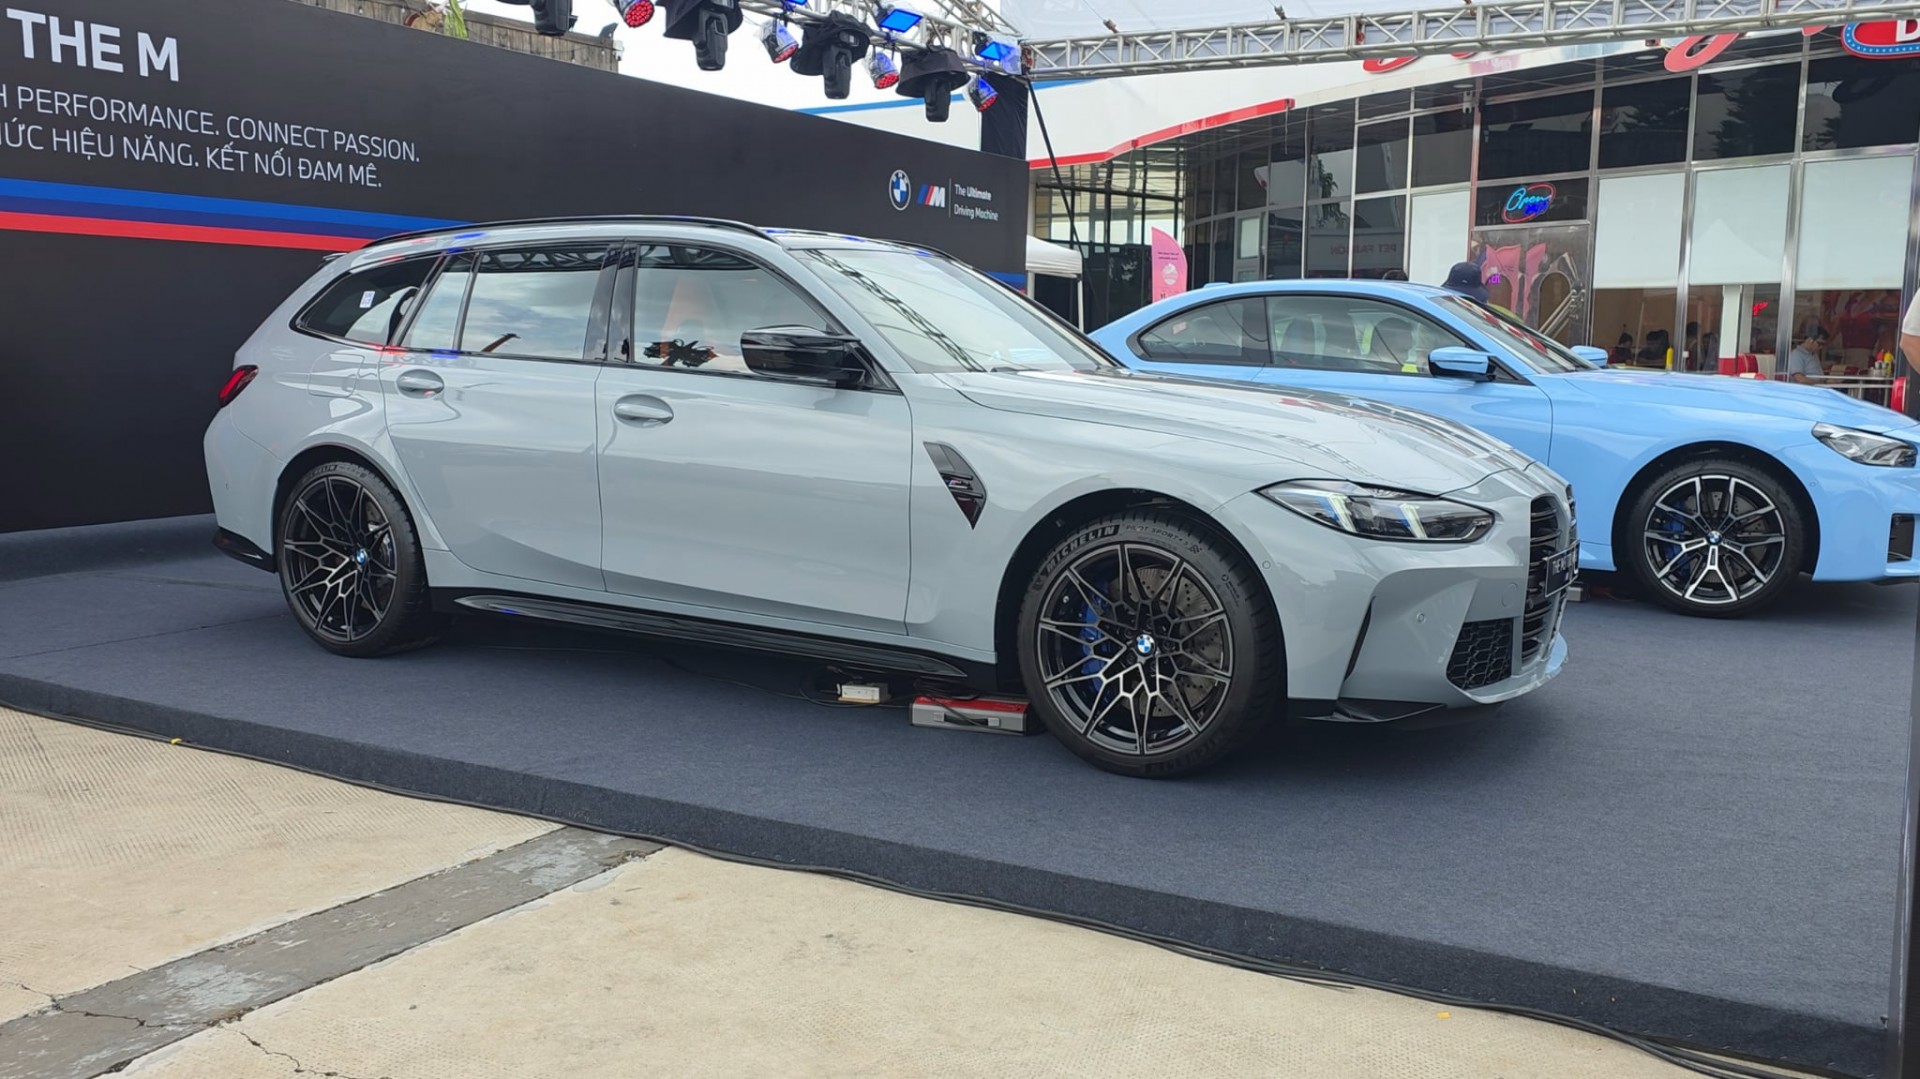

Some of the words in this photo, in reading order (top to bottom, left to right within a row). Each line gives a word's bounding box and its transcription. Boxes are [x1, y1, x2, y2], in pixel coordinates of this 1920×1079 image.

[7, 8, 124, 73] THE
[138, 31, 179, 82] M
[0, 116, 44, 150] ỨC
[52, 126, 114, 161] HIỆU
[123, 134, 199, 167] NĂNG.
[206, 141, 249, 172] KẾT
[254, 147, 292, 178] NỐI
[297, 158, 343, 184] ĐAM
[349, 162, 382, 188] MÊ.
[17, 86, 220, 136] PERFORMANCE.
[226, 115, 329, 149] CONNECT
[333, 130, 420, 162] PASSION.
[954, 184, 966, 197] The
[966, 186, 992, 201] Ultimate
[954, 203, 975, 220] Driving
[975, 206, 999, 222] Machine
[1045, 525, 1115, 573] MICHELIN
